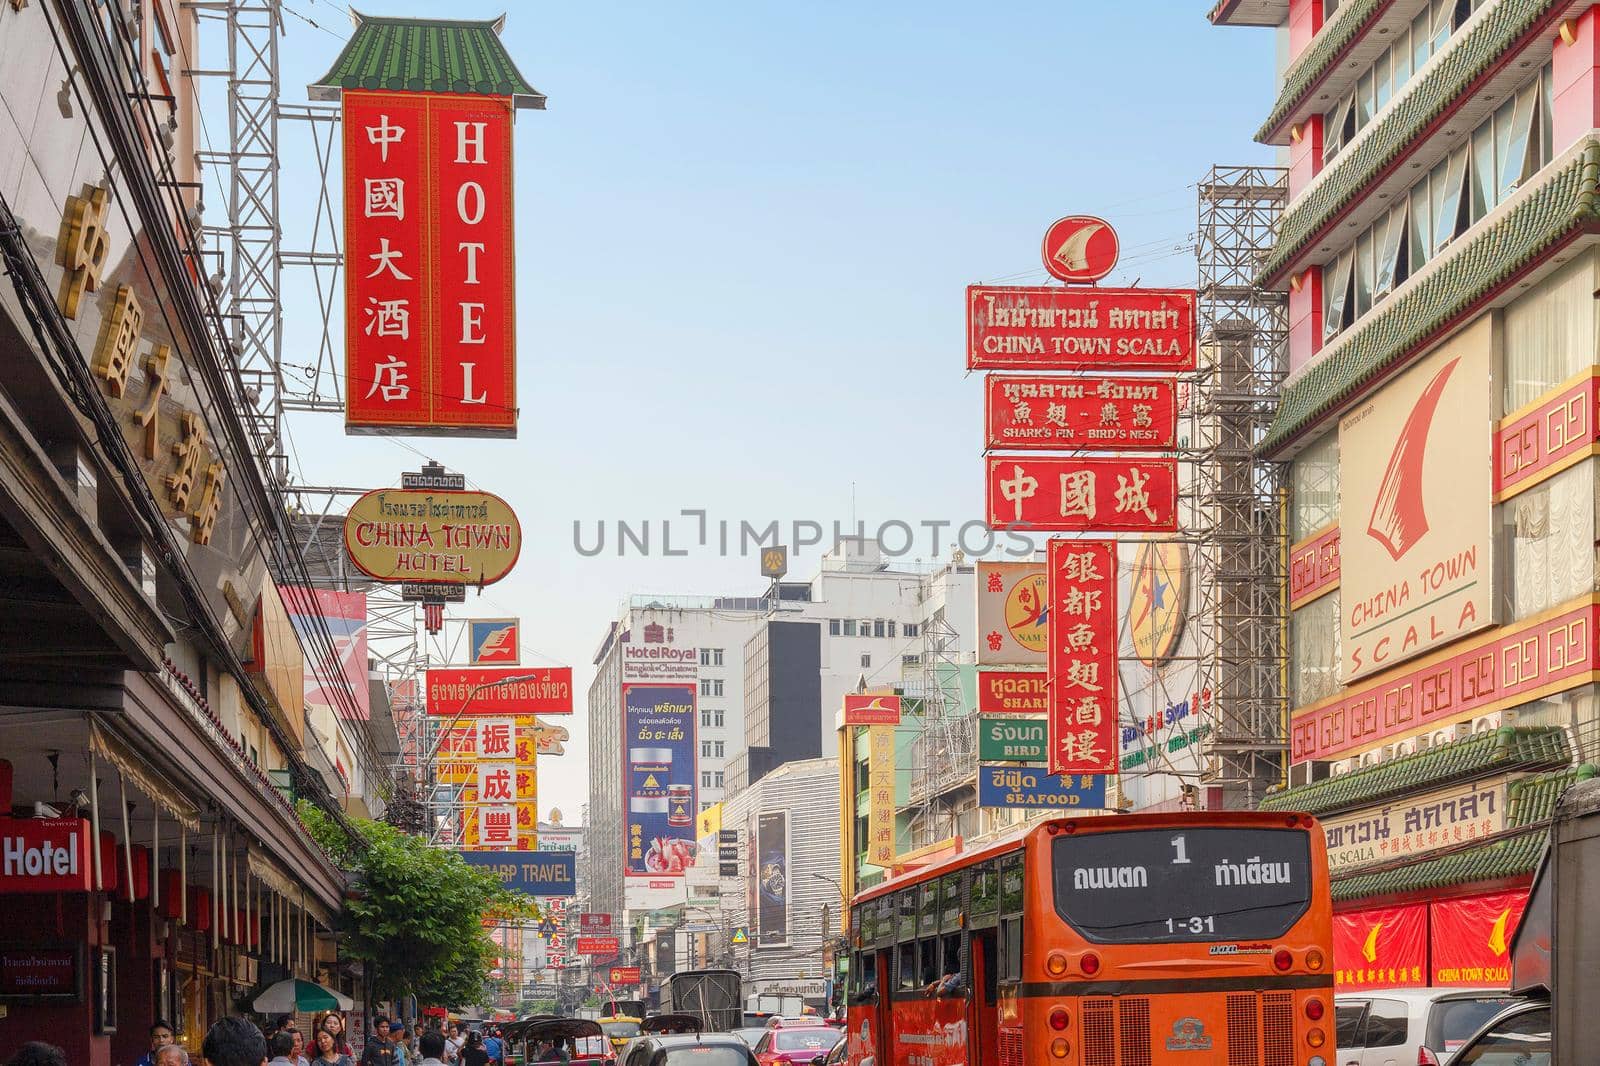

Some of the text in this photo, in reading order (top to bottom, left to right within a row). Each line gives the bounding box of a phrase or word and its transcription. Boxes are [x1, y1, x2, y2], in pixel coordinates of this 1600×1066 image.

[363, 114, 413, 404] 中國大酒店
[452, 120, 490, 406] HOTEL
[984, 296, 1179, 330] ไชน่าทาวน์ สกาล่า
[983, 335, 1182, 357] CHINA TOWN SCALA
[1003, 427, 1051, 439] SHARK'S
[1055, 428, 1075, 439] FIN
[1088, 429, 1127, 440] BIRD'S
[1129, 429, 1159, 441] NEST
[999, 465, 1158, 523] 中國城
[355, 522, 513, 551] CHINA TOWN
[396, 552, 472, 573] HOTEL
[1350, 544, 1477, 628] CHINA TOWN
[1350, 599, 1477, 674] SCALA
[625, 646, 697, 662] Hotel Royal
[1061, 551, 1107, 765] 銀都魚翅酒樓
[991, 722, 1043, 741] รังนก
[1003, 745, 1040, 756] BIRD
[482, 724, 513, 842] 振成豐
[1006, 793, 1080, 805] SEAFOOD
[3, 832, 78, 876] Hotel
[1170, 835, 1192, 865] 1
[1339, 846, 1375, 866] SCALA
[521, 863, 571, 883] TRAVEL
[1073, 855, 1292, 890] ถนนตก ท่าเตียน
[1165, 916, 1216, 934] 1-31
[1438, 967, 1509, 983] CHINA TOWN SCALA
